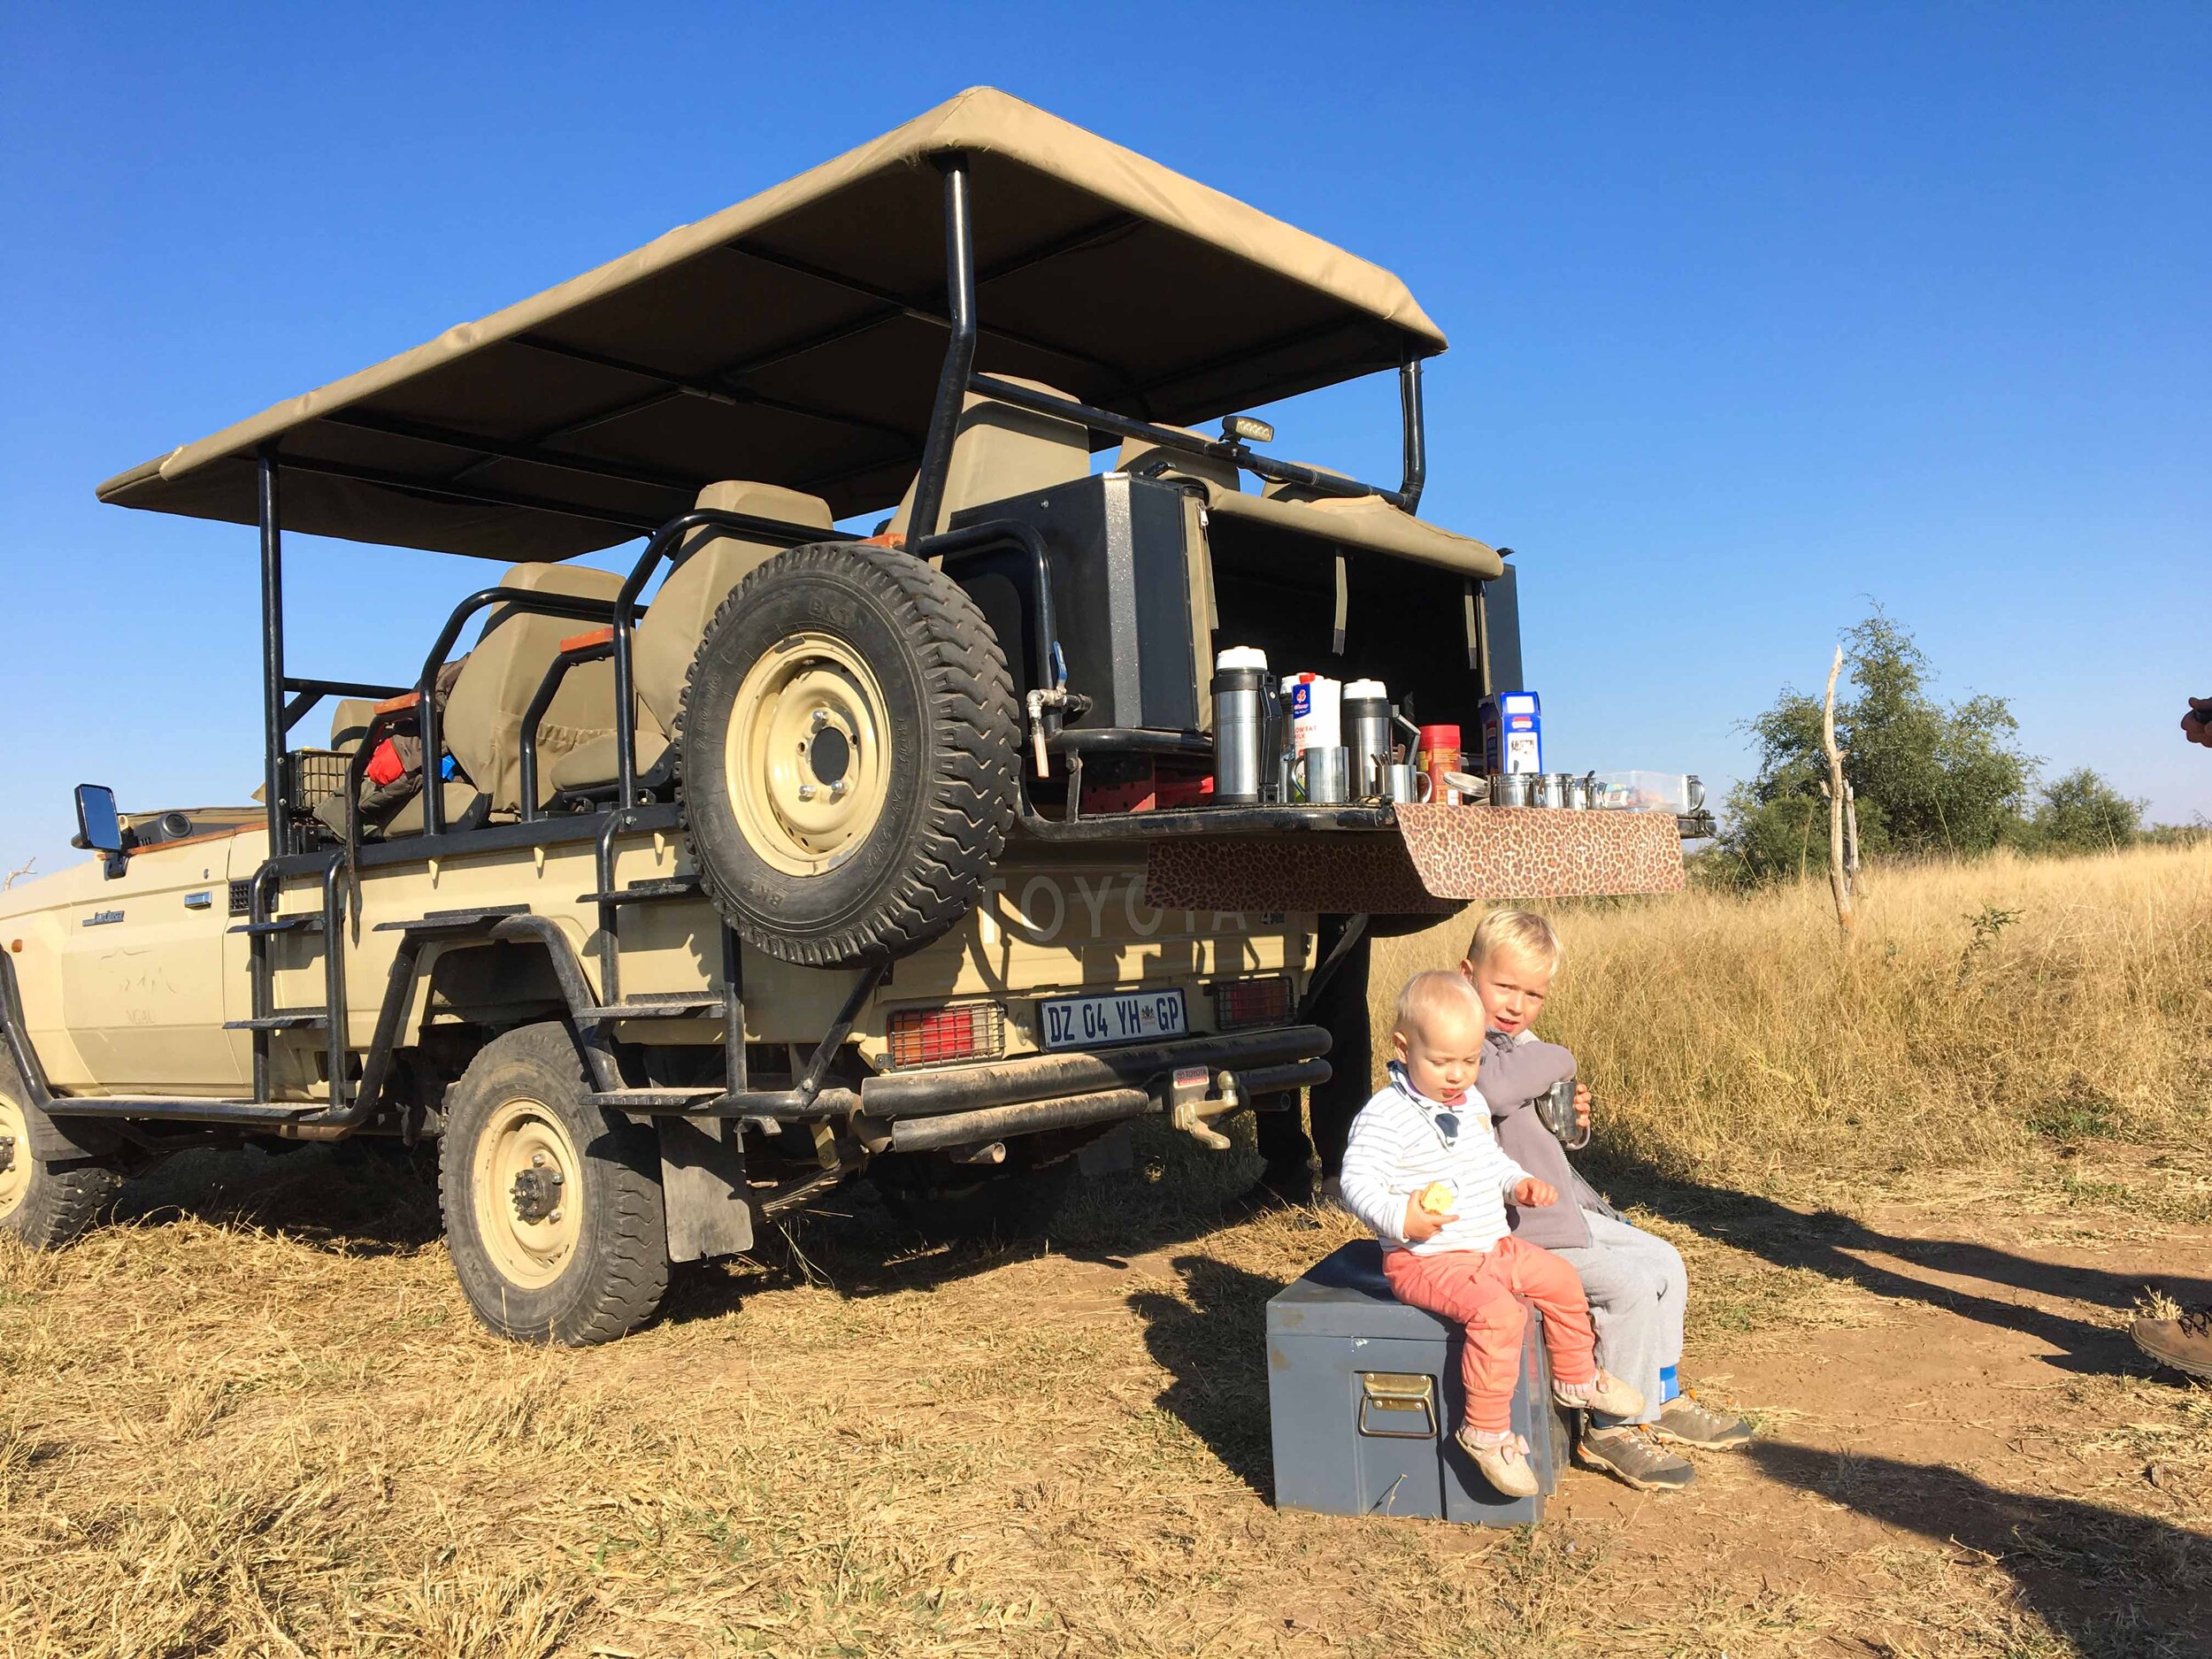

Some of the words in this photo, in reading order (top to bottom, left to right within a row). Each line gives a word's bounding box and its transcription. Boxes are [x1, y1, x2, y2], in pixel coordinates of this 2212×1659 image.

[1048, 1005, 1075, 1042] DZ
[1082, 1003, 1108, 1039] 04
[1116, 1000, 1141, 1035] YH
[1156, 996, 1179, 1031] GP
